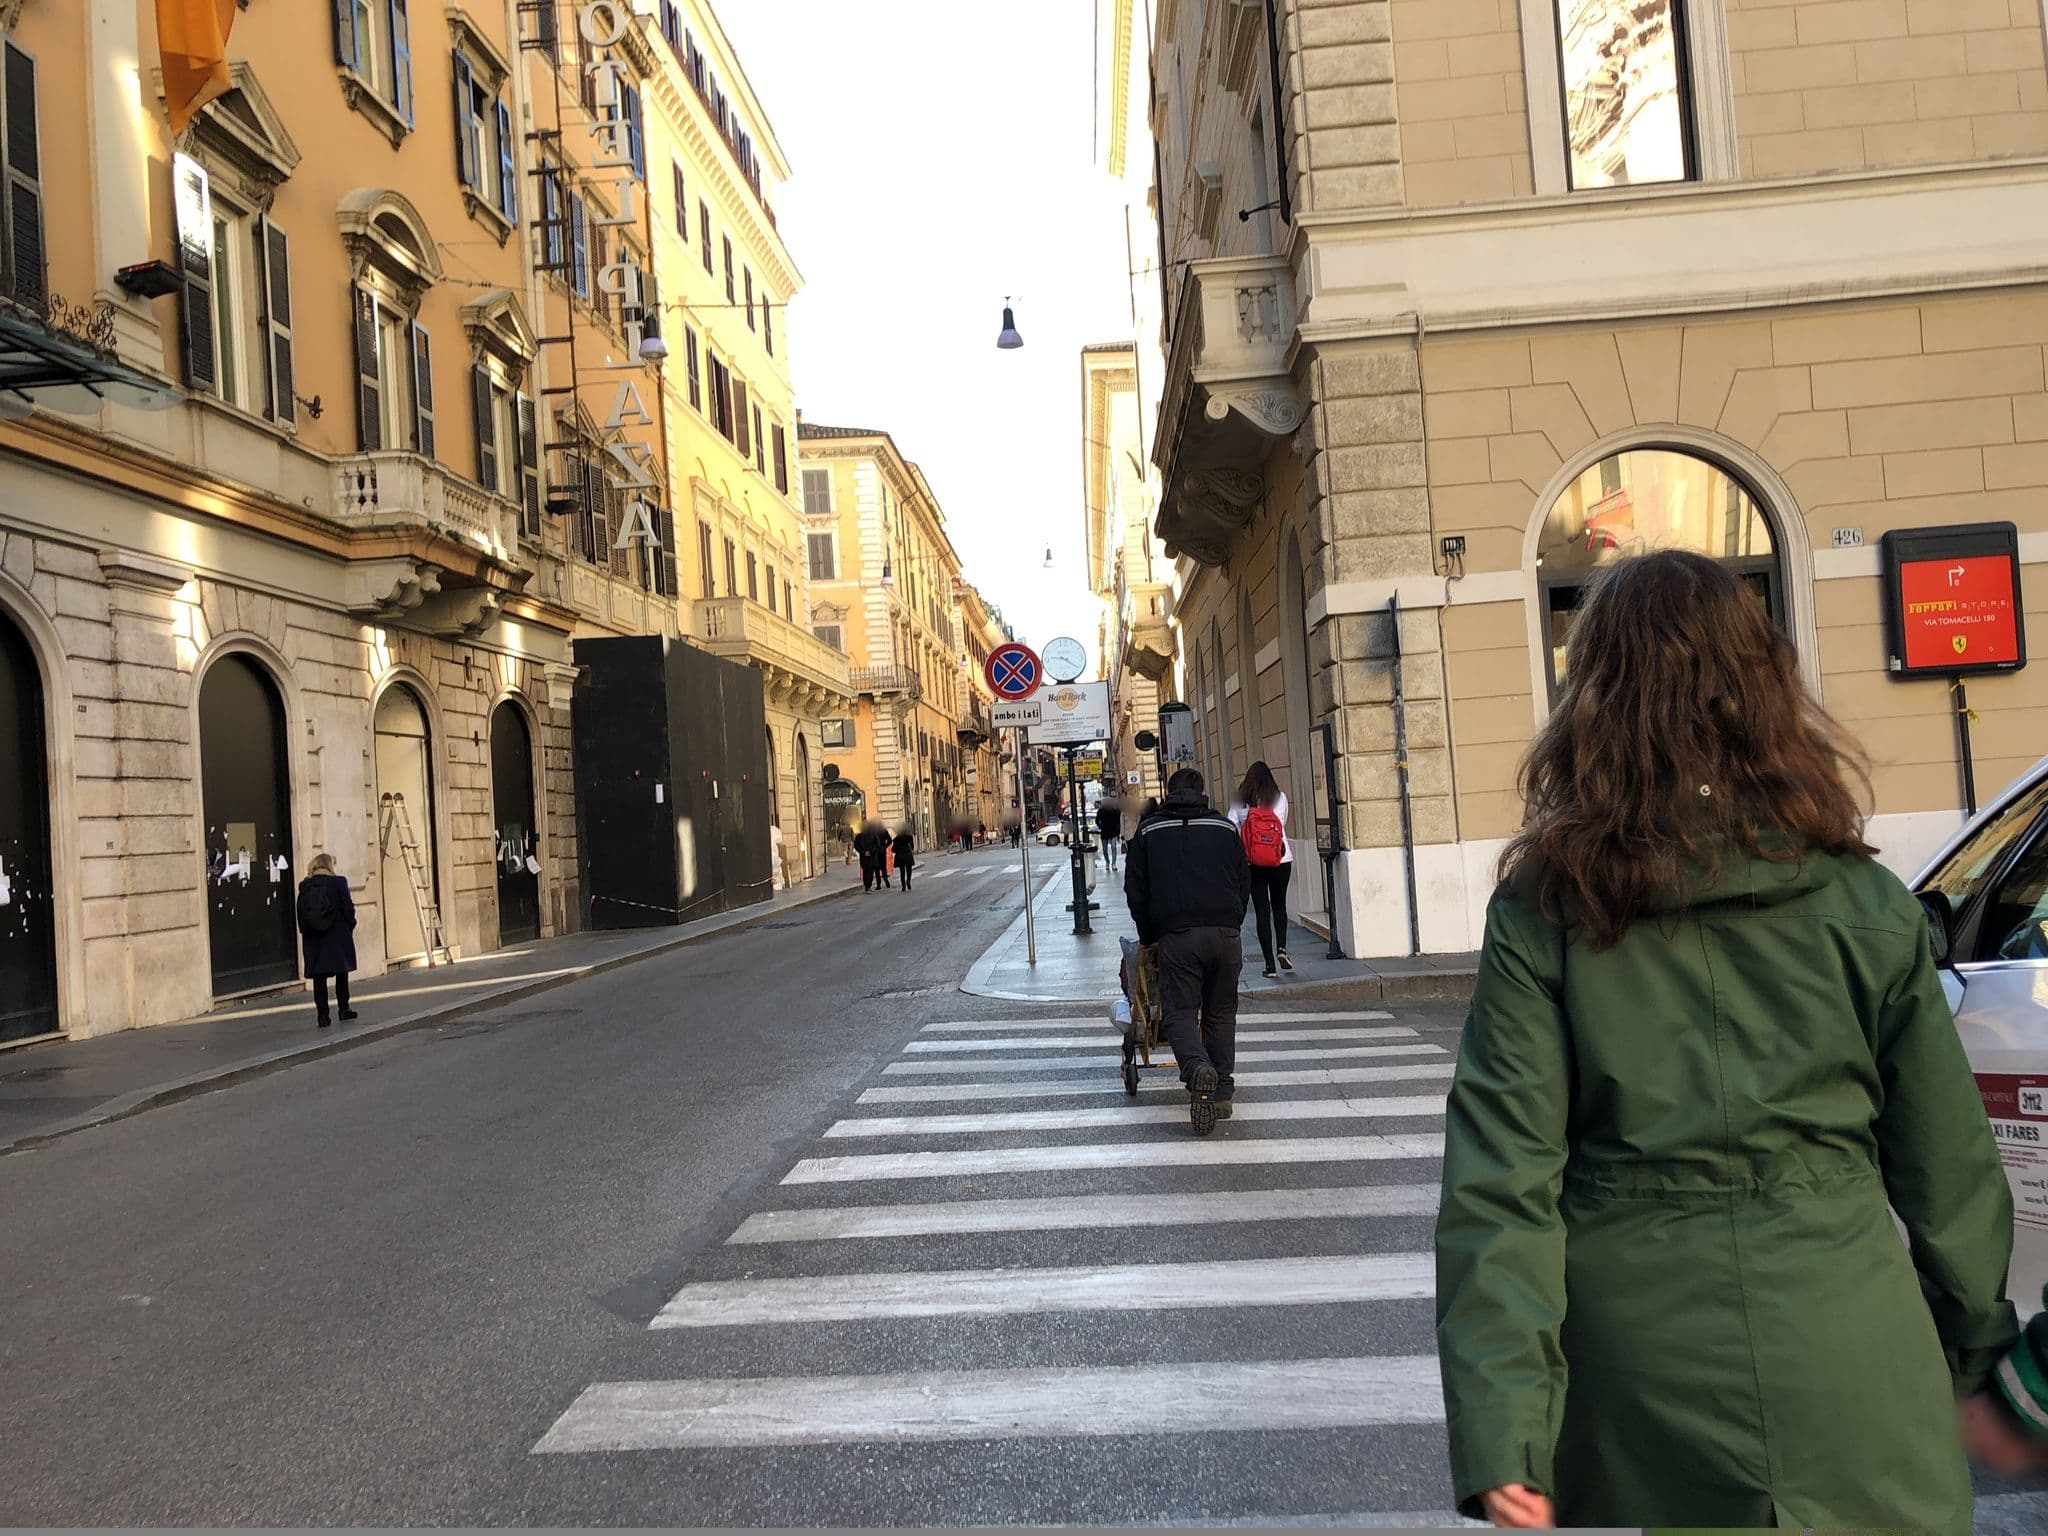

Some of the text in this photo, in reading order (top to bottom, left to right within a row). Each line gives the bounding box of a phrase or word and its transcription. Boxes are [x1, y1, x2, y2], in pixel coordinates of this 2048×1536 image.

[1834, 530, 1861, 546] 426
[1908, 600, 1957, 614] Ferrari
[1924, 618, 1937, 626] VIA
[1937, 615, 1981, 626] TOMACELLI
[1047, 691, 1087, 702] Hard Rock
[994, 710, 1016, 720] ambo
[1023, 709, 1039, 719] lati
[2006, 1124, 2040, 1142] FARES
